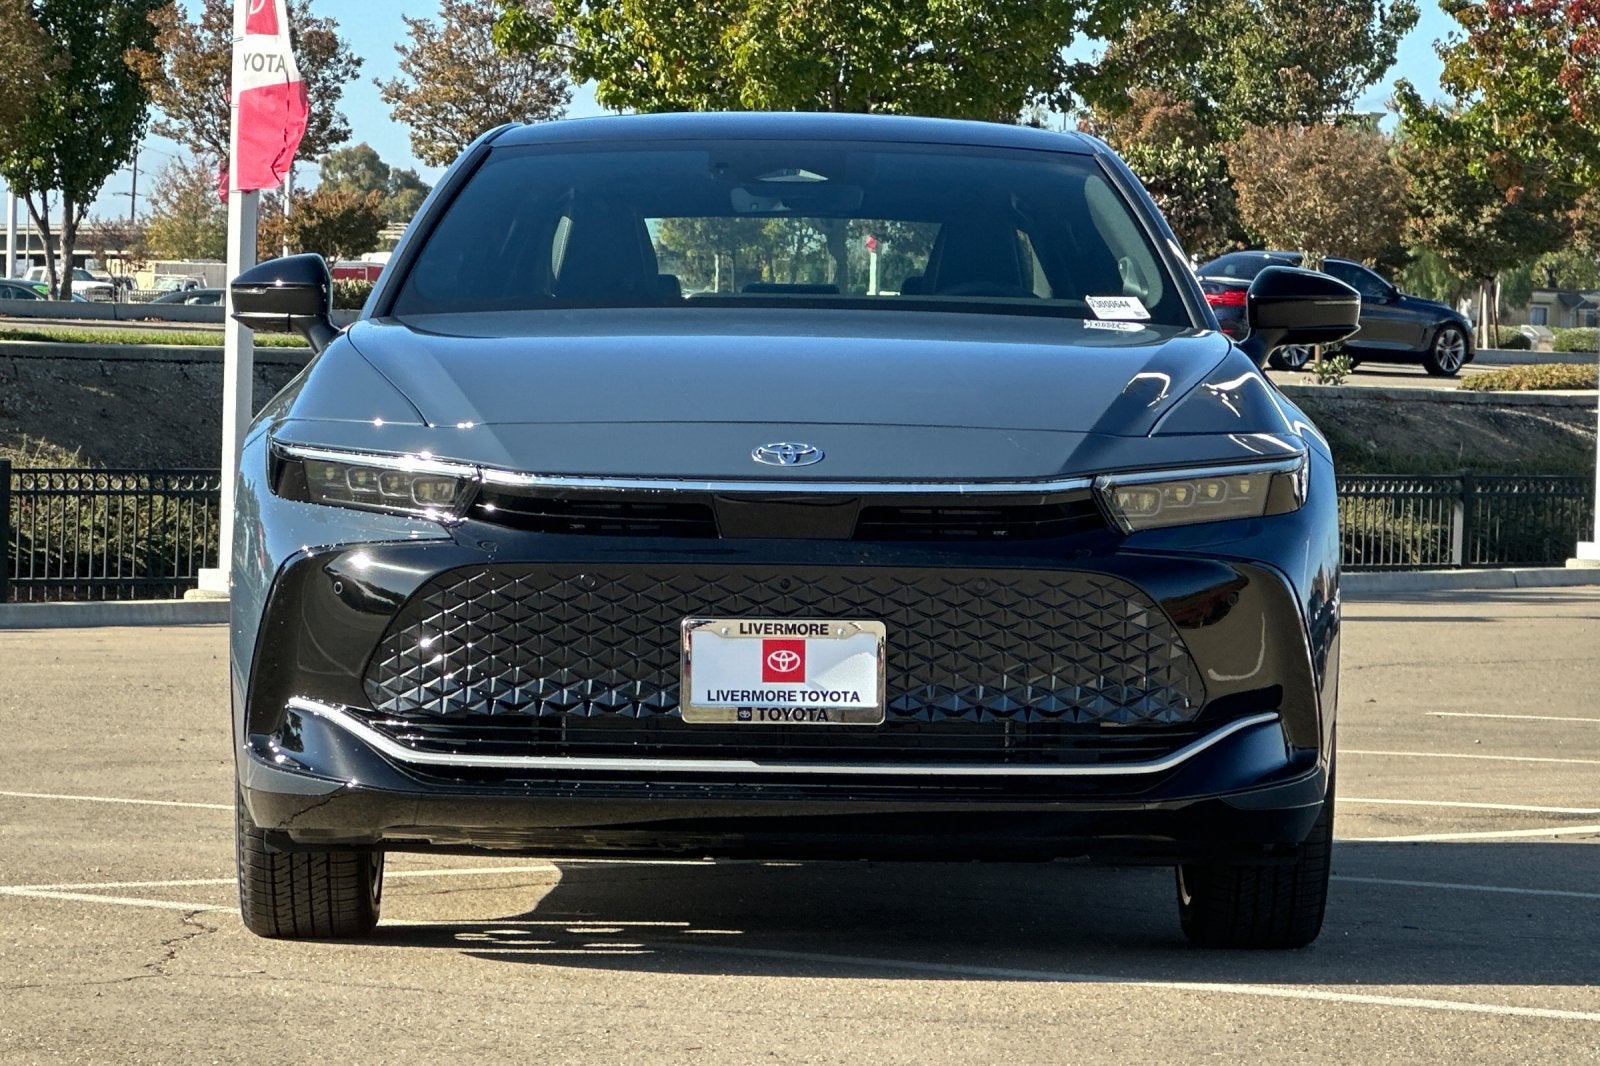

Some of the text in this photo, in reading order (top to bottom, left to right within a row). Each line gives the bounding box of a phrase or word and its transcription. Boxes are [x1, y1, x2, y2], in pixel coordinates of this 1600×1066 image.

[739, 622, 830, 636] LIVERMORE
[707, 689, 860, 703] LIVERMORE TOYOTA
[757, 707, 829, 721] TOYOTA
